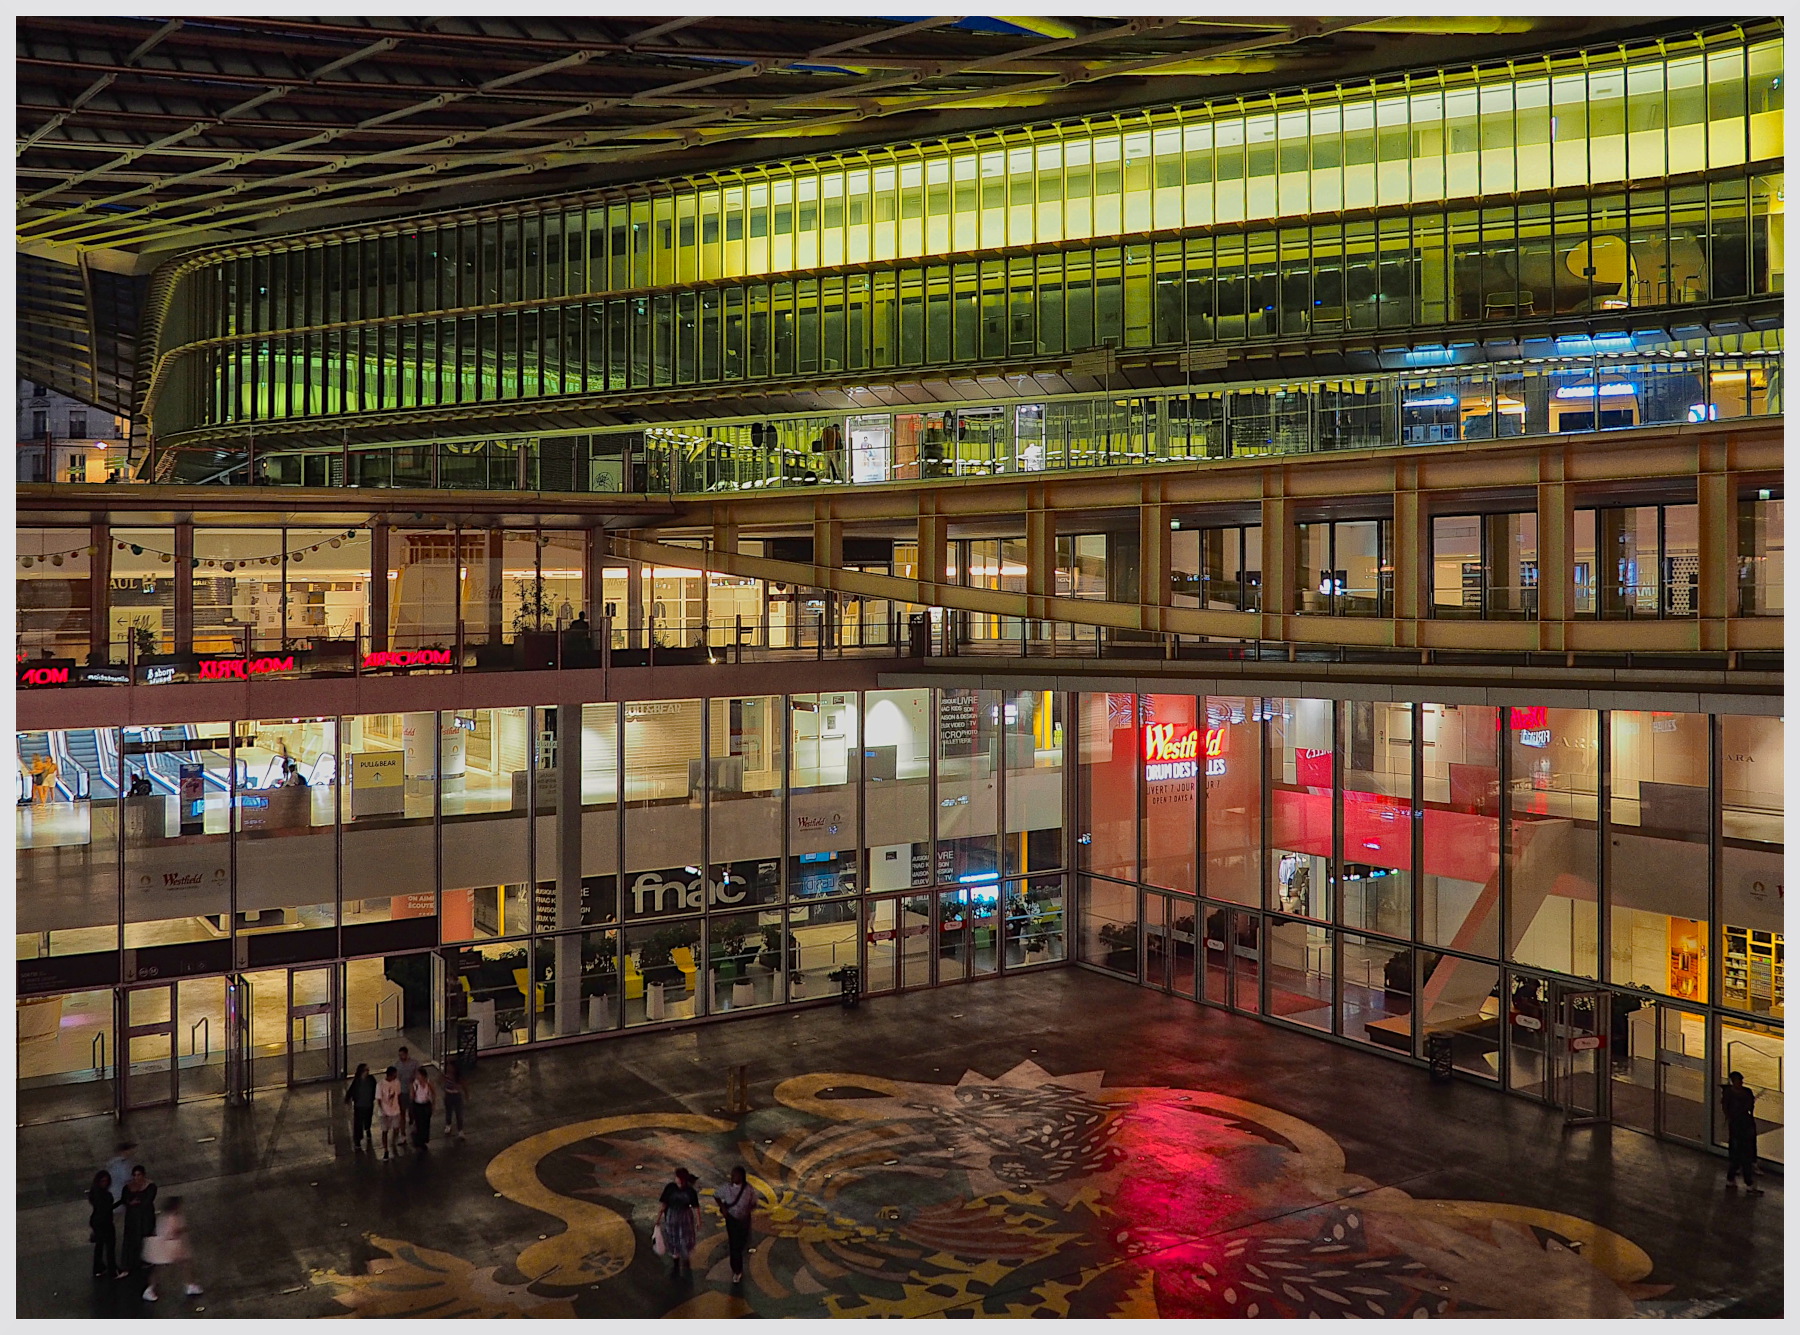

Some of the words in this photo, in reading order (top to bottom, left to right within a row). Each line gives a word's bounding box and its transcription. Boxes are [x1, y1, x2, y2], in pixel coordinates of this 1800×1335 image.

[110, 579, 137, 590] AUL
[957, 696, 979, 705] LIVRE
[941, 713, 955, 721] AISON
[1724, 754, 1755, 763] ARA
[360, 760, 397, 768] PULL&BEAR
[1173, 761, 1191, 779] DES
[1177, 782, 1195, 793] JOUR
[1152, 796, 1167, 804] OPEN
[1173, 795, 1188, 803] DAYS
[162, 872, 204, 887] Westfield
[631, 872, 748, 914] fnac
